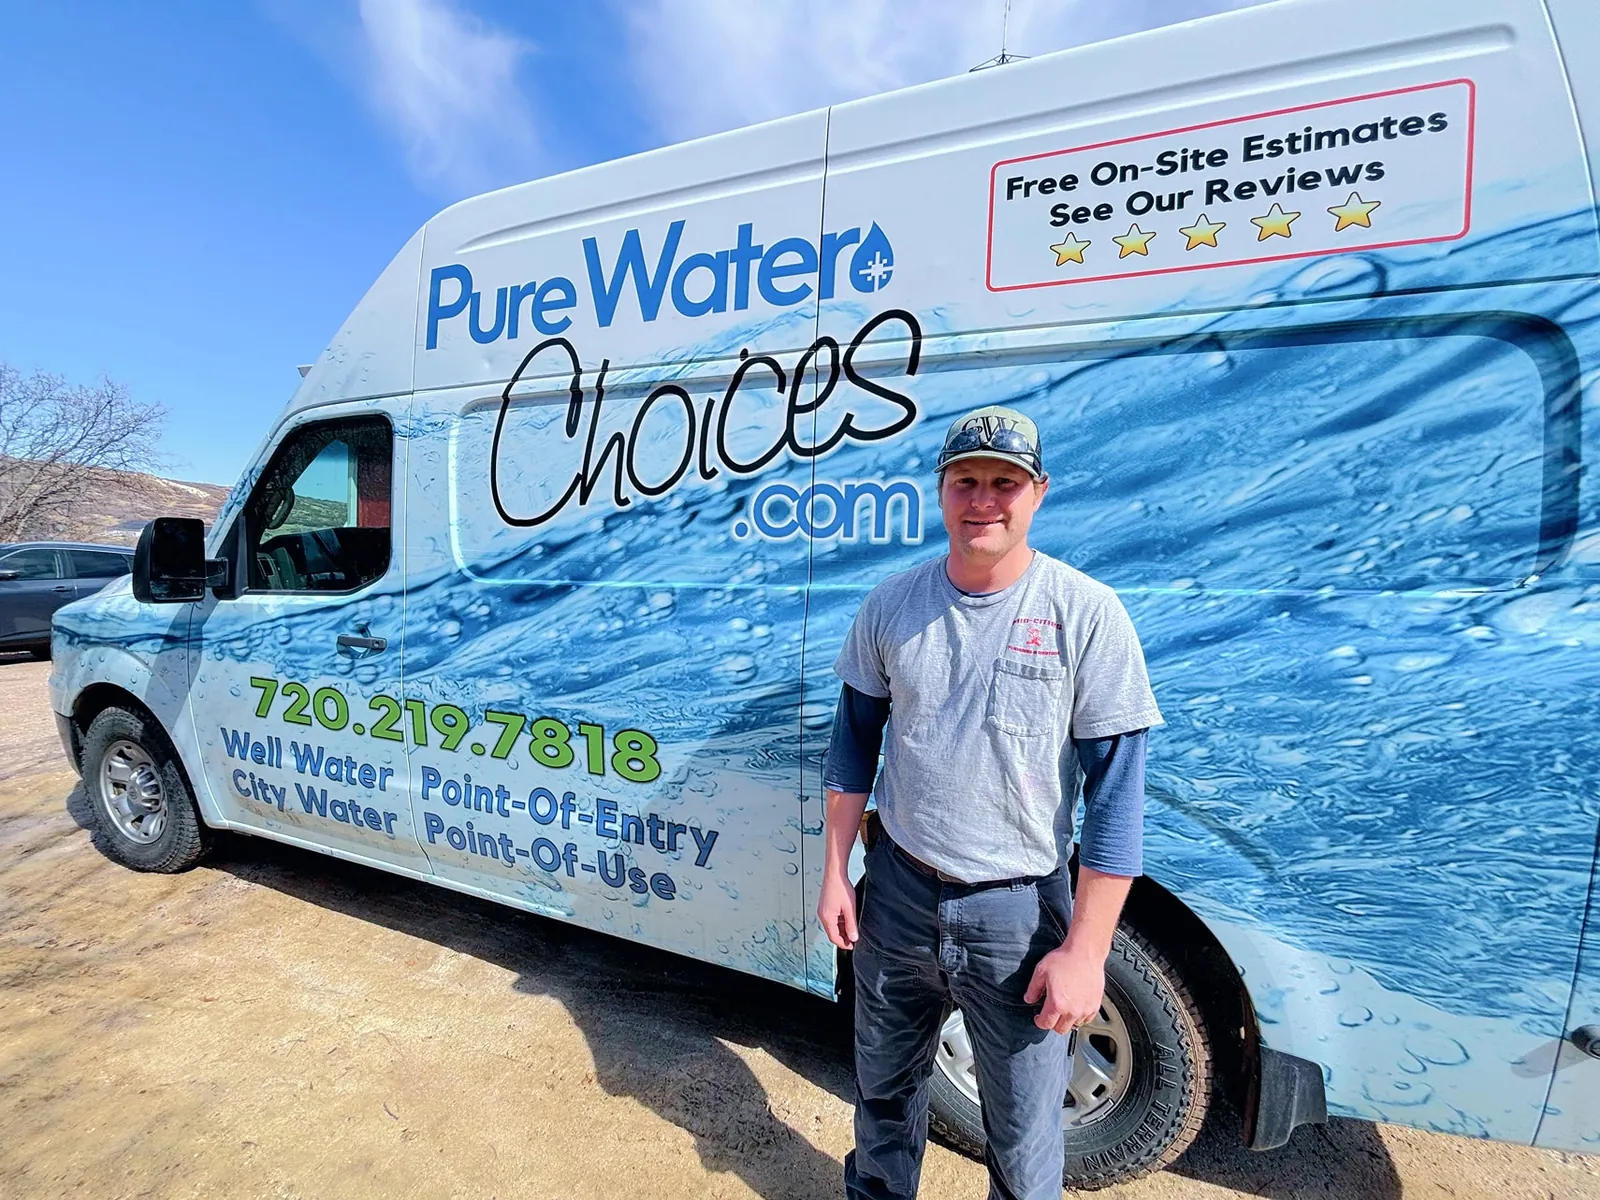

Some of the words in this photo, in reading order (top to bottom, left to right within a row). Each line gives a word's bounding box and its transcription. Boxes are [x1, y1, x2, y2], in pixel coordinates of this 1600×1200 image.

[1006, 169, 1079, 202] Free
[1090, 146, 1229, 186] On-Site
[1241, 110, 1449, 164] Estimates
[1049, 199, 1114, 228] See
[1126, 186, 1194, 217] Our
[1204, 156, 1385, 207] Reviews
[425, 263, 578, 351] Pure
[581, 219, 862, 329] Water
[490, 309, 922, 528] Choices
[733, 480, 922, 541] .com
[220, 727, 283, 769] Well
[291, 740, 394, 792] Water
[250, 676, 662, 783] 720.219.7818
[232, 767, 287, 813] City
[295, 782, 398, 835] Water
[420, 765, 720, 867] Point-Of-Entry
[424, 811, 677, 900] Point-Of-Use
[1153, 1041, 1177, 1090] ALL
[1082, 1099, 1174, 1171] TERRAIN
